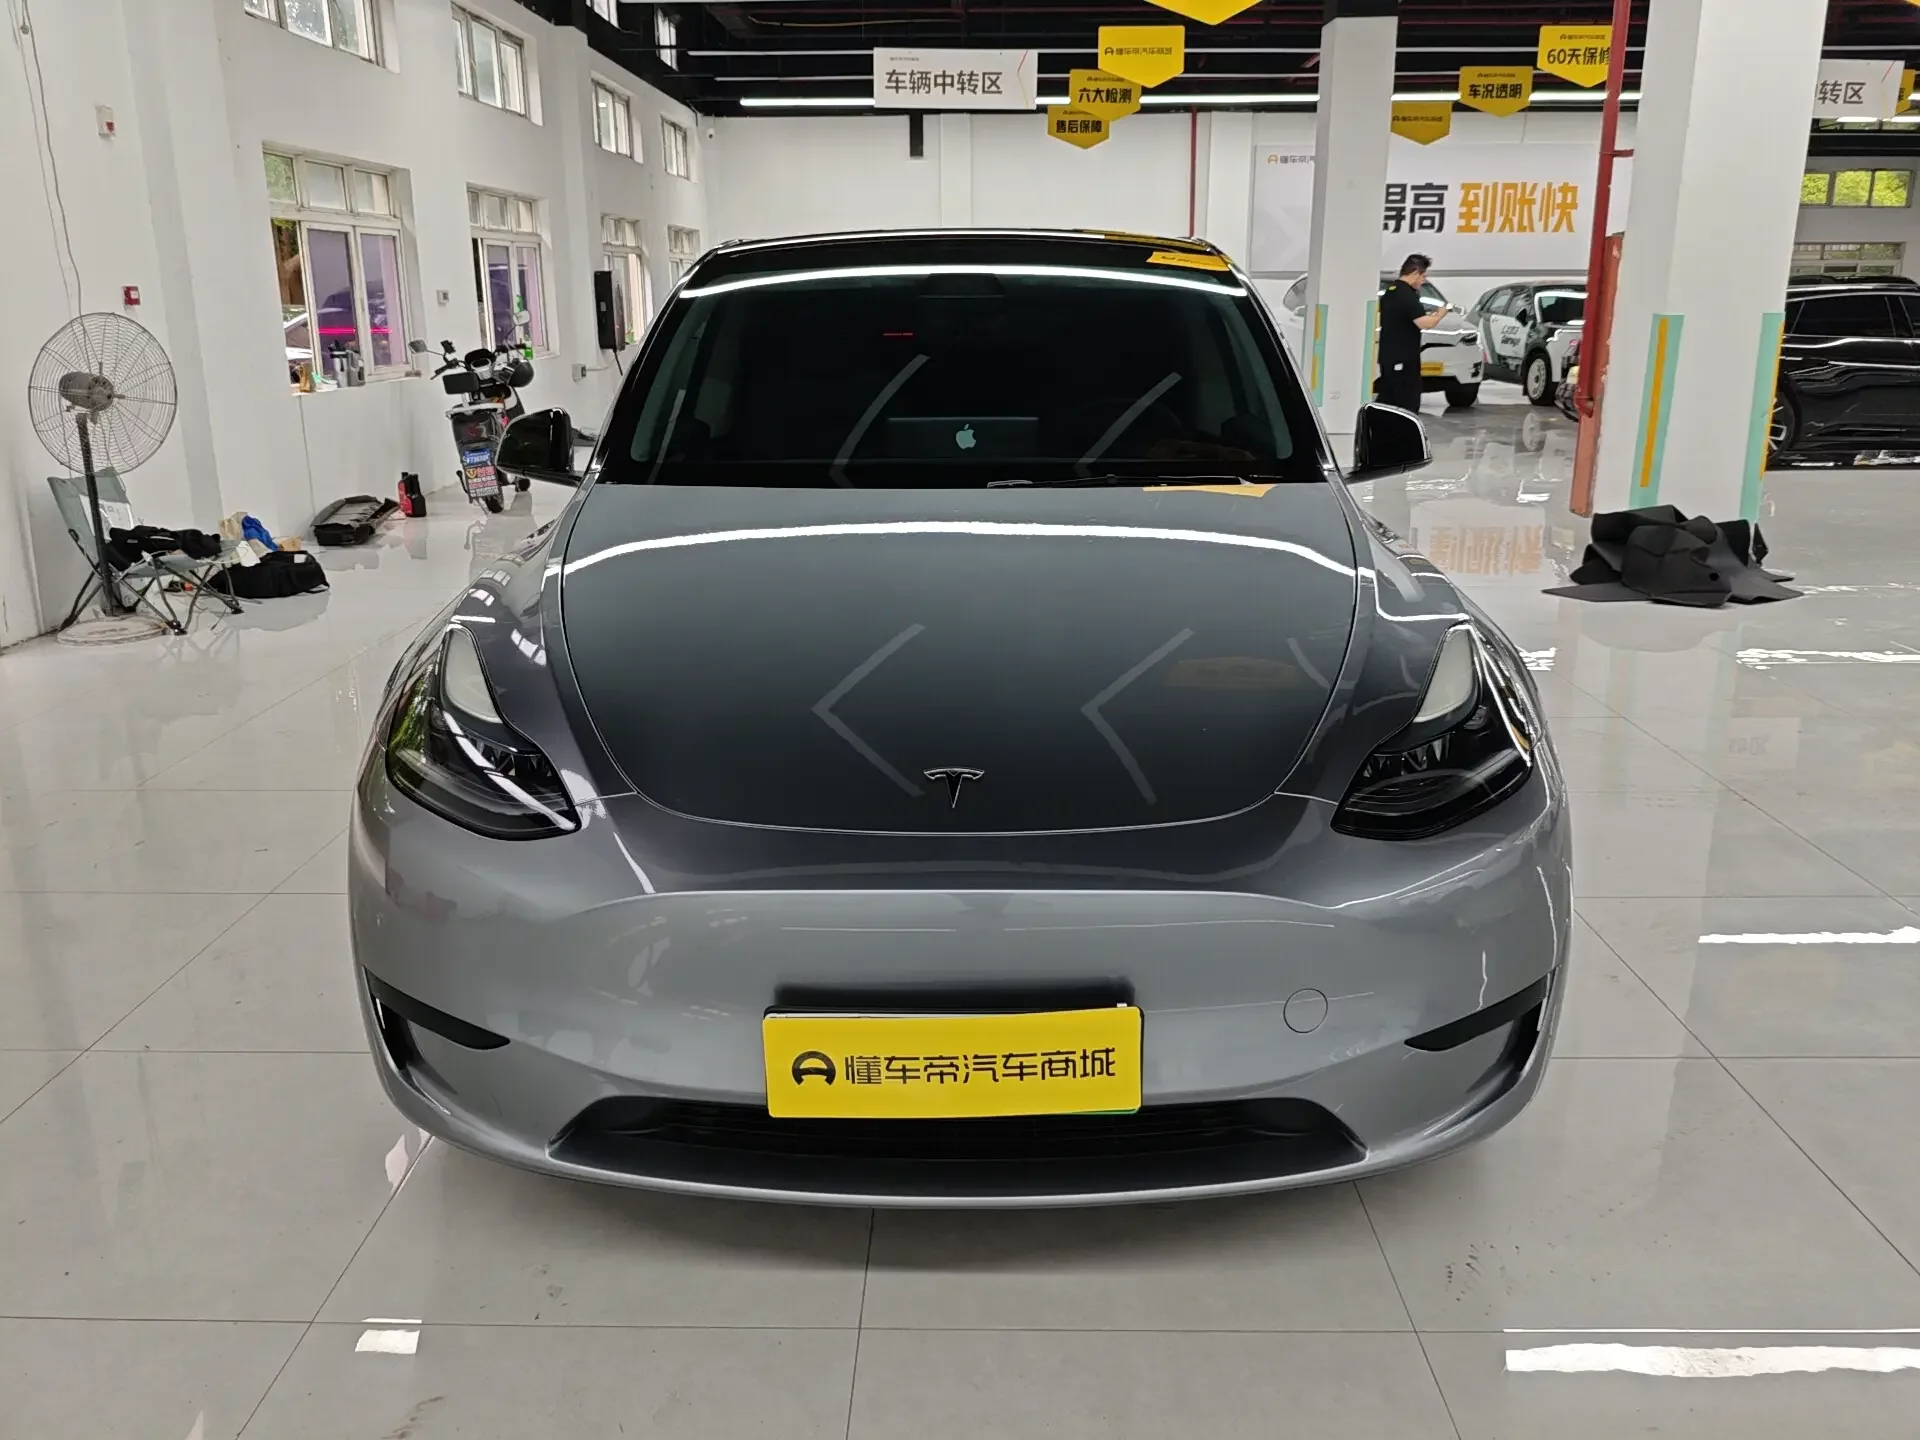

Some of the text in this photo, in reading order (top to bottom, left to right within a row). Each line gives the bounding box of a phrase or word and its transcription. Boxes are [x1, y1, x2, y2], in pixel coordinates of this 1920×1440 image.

[885, 69, 1003, 95] 车辆中转区
[1468, 83, 1523, 99] 车况透明
[1814, 80, 1866, 104] 转区
[1078, 87, 1132, 104] 六大检测
[1056, 120, 1102, 133] 售后保障
[1456, 181, 1578, 233] 到账快
[844, 1047, 1116, 1085] 懂车帝汽车商城
